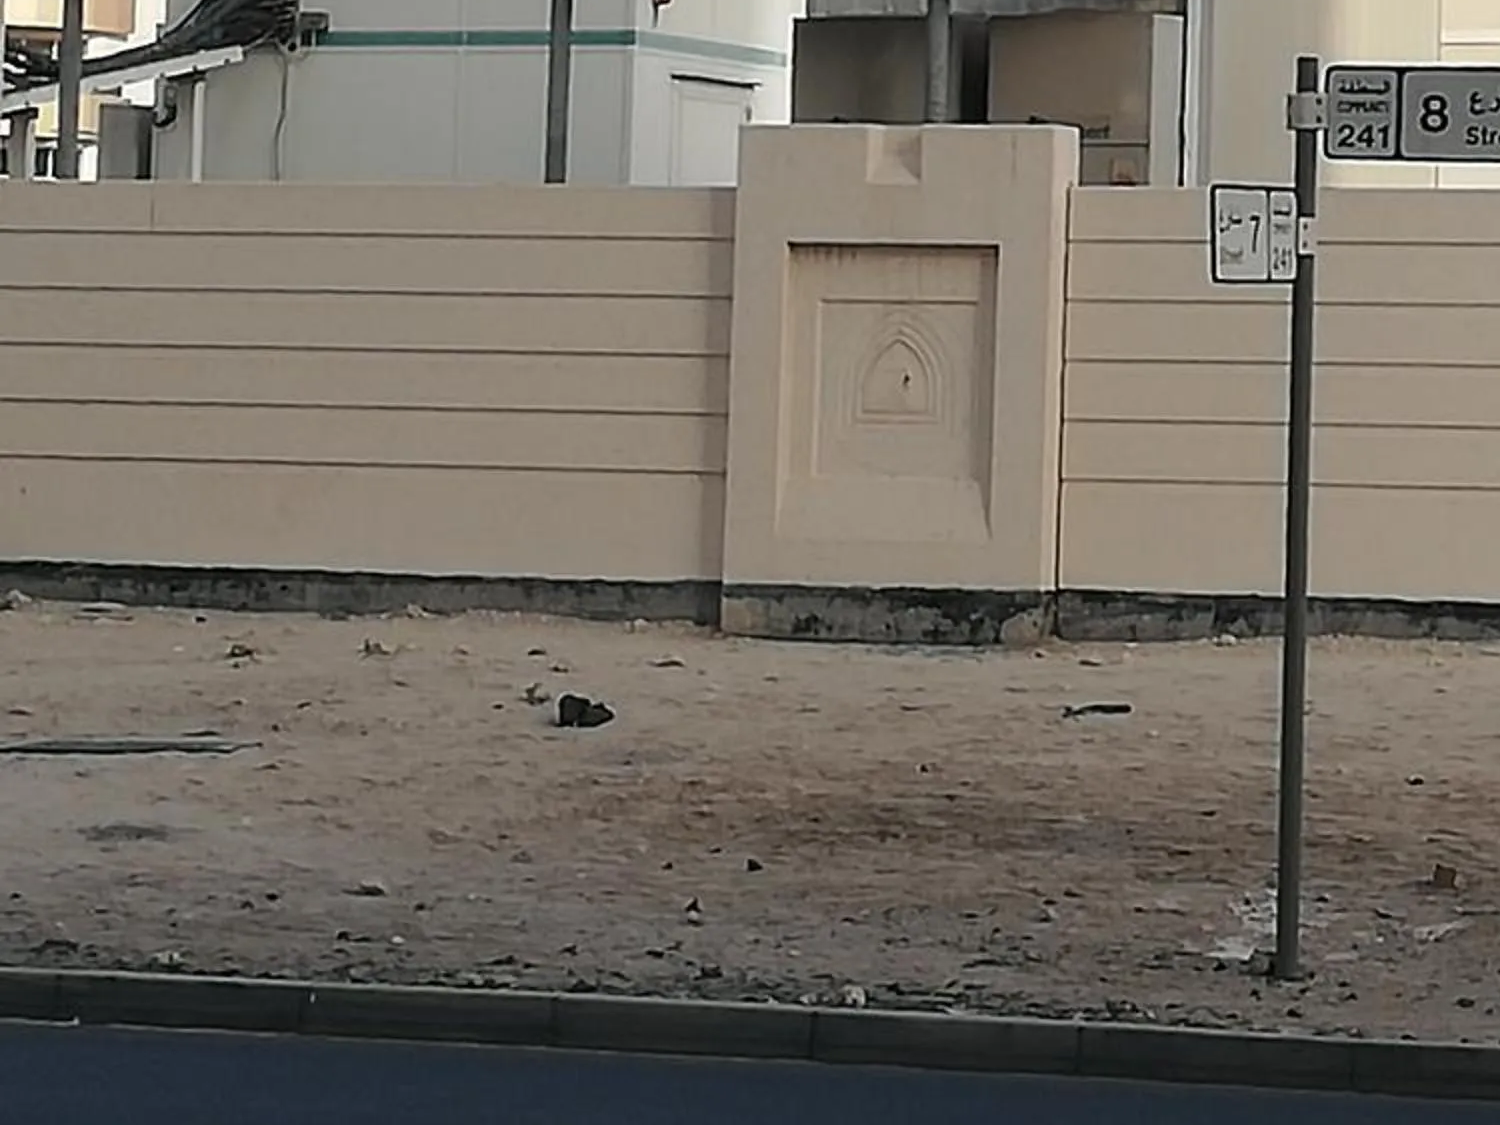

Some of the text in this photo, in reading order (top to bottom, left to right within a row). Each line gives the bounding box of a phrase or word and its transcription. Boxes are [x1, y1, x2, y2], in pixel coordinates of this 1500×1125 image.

[1420, 95, 1449, 132] 8
[1338, 124, 1390, 148] 241
[1249, 215, 1261, 253] 7
